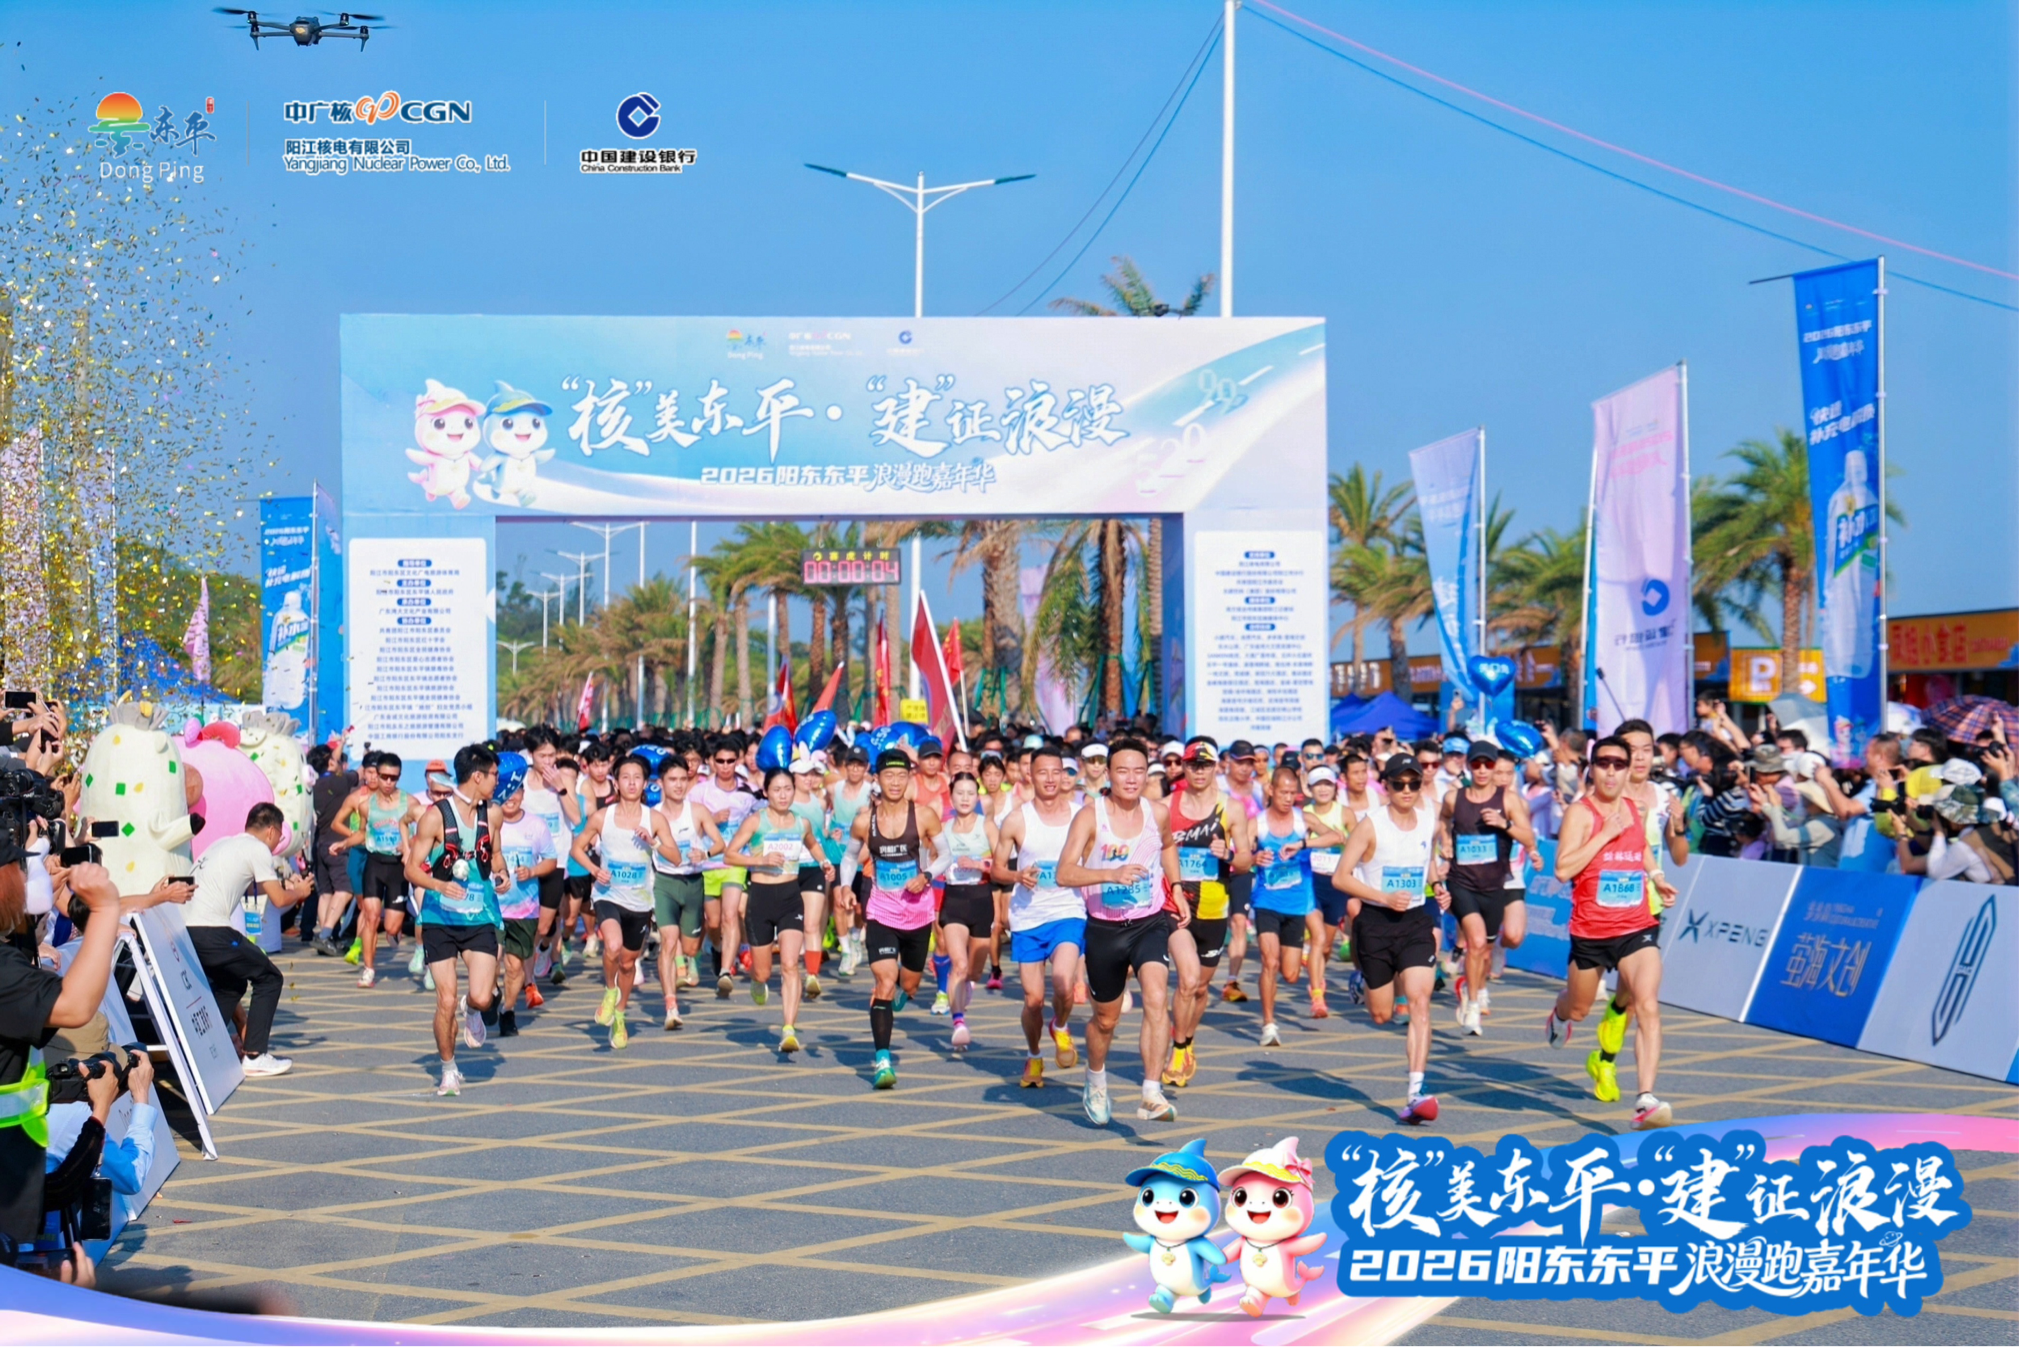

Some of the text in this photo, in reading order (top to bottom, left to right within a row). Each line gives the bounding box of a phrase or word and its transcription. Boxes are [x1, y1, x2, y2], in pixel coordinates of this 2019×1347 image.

[804, 560, 899, 583] 00:00:04
[767, 842, 794, 851] A2002
[1460, 845, 1487, 853] A1033
[611, 869, 638, 879] A1028
[880, 871, 908, 881] A1005
[1386, 879, 1417, 888] A1303
[1703, 920, 1769, 947] XPENG
